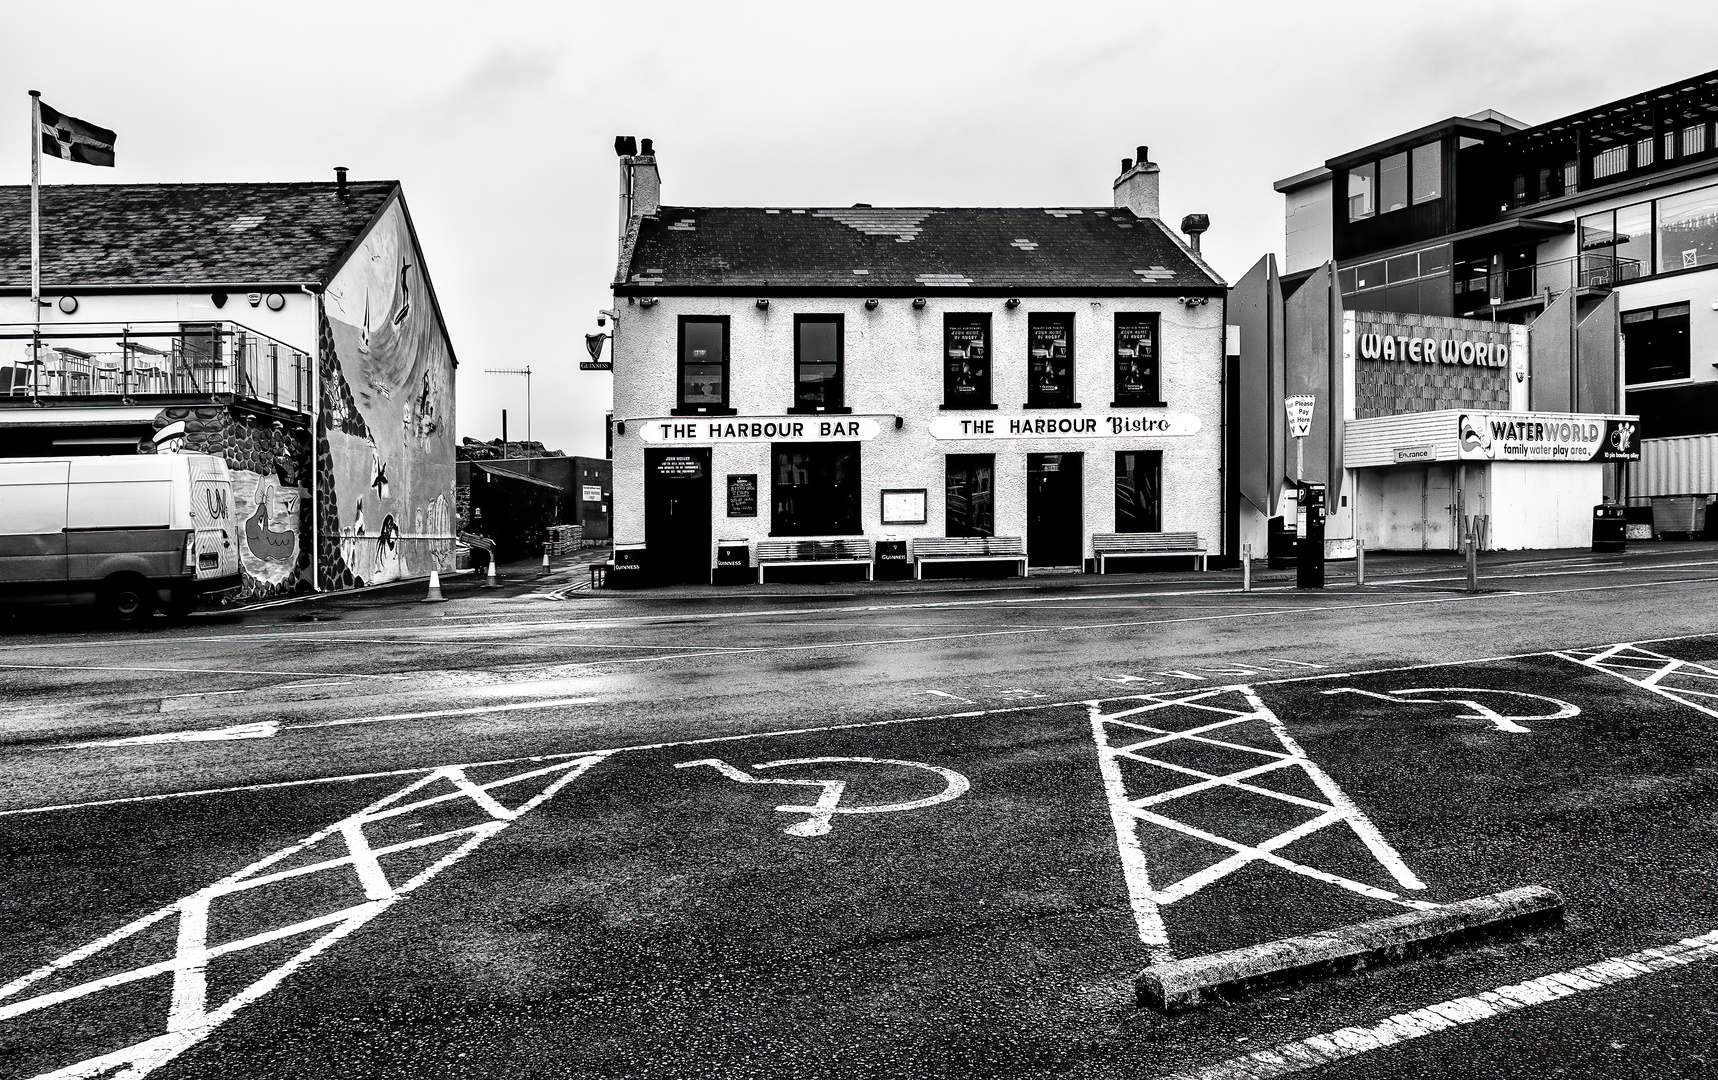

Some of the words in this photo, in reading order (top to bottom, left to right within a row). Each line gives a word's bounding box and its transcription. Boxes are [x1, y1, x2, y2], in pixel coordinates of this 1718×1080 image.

[1361, 334, 1436, 362] WATER
[1440, 340, 1508, 367] WORLD
[661, 424, 696, 438] THE
[710, 422, 804, 438] HARBOUR
[820, 422, 860, 436] BAR
[960, 420, 994, 434] THE
[1010, 418, 1096, 433] HARBOUR
[1106, 416, 1171, 434] Bistro
[1490, 421, 1598, 442] WATERWORLD
[1504, 444, 1528, 456] family
[1529, 446, 1550, 454] water
[1553, 444, 1569, 457] play
[1570, 446, 1587, 454] area
[1299, 490, 1304, 499] P
